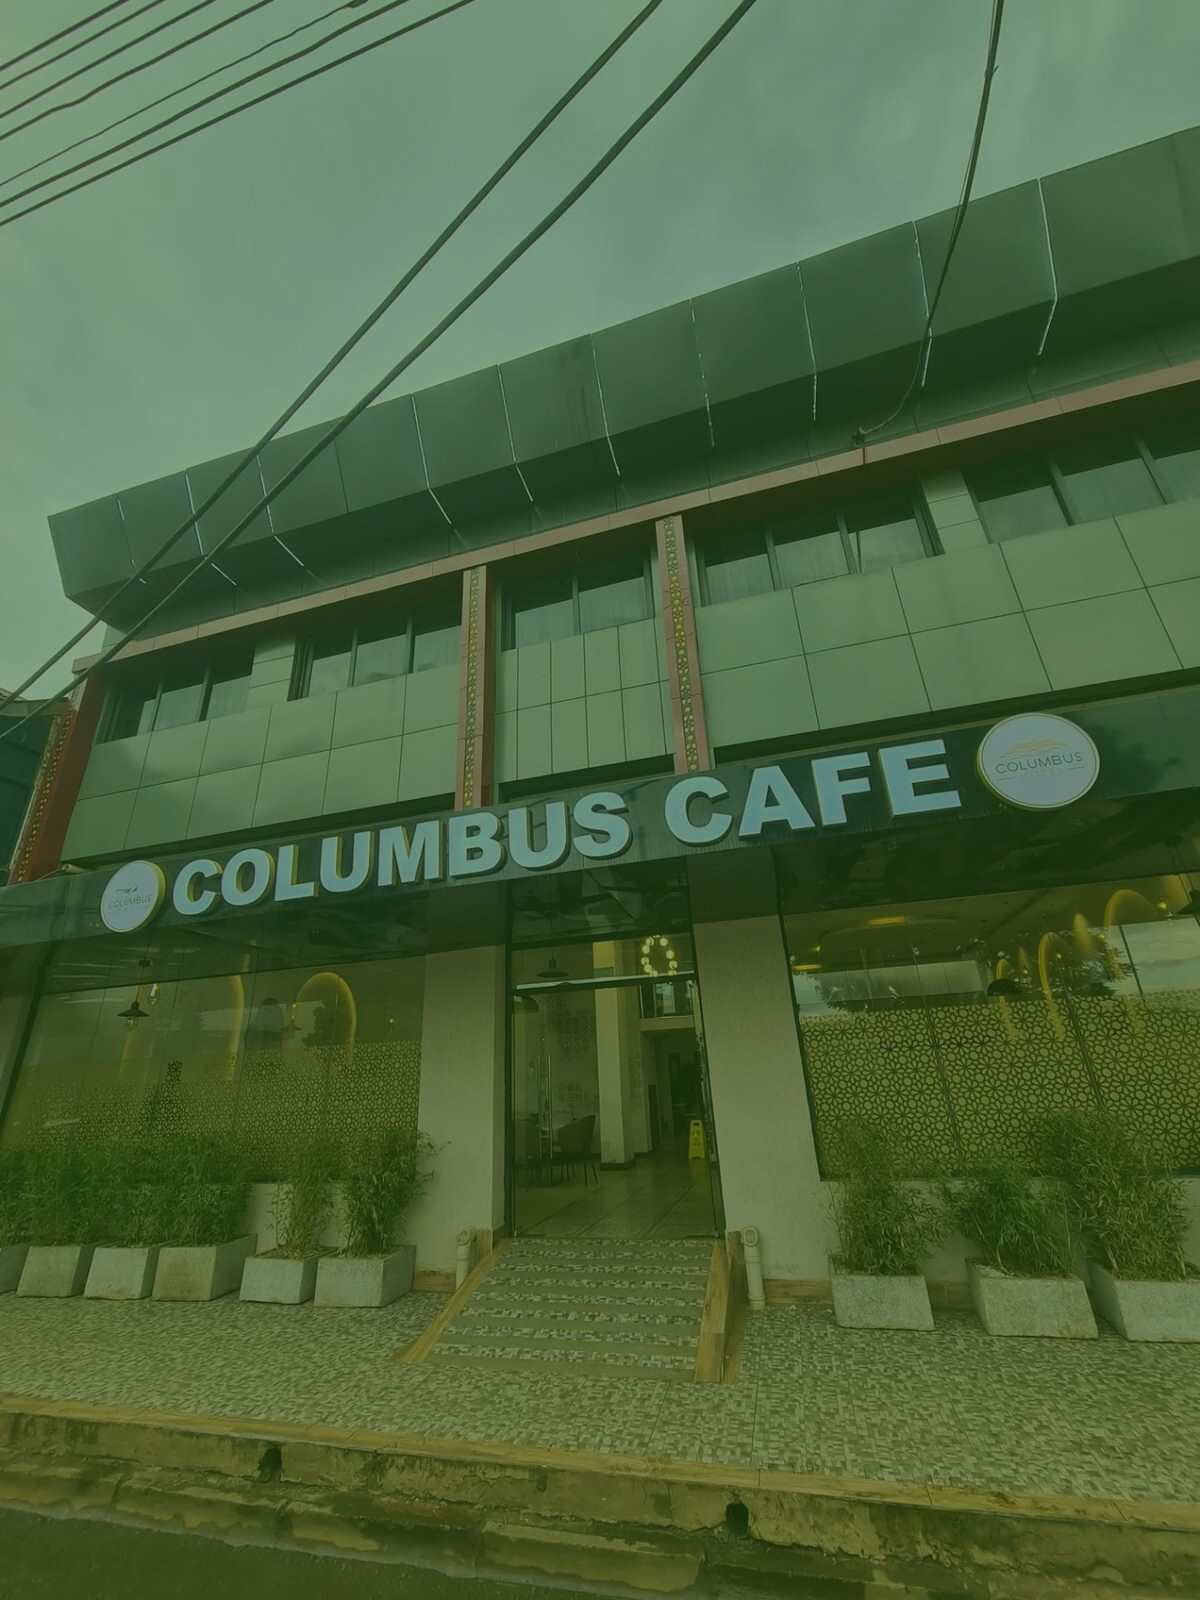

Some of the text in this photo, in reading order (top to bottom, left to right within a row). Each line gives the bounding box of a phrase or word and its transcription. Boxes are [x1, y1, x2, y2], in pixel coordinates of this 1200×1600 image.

[995, 751, 1083, 774] COLUMBUS
[173, 739, 962, 917] COLUMBUS CAFE
[108, 894, 152, 909] COLUMBUS
